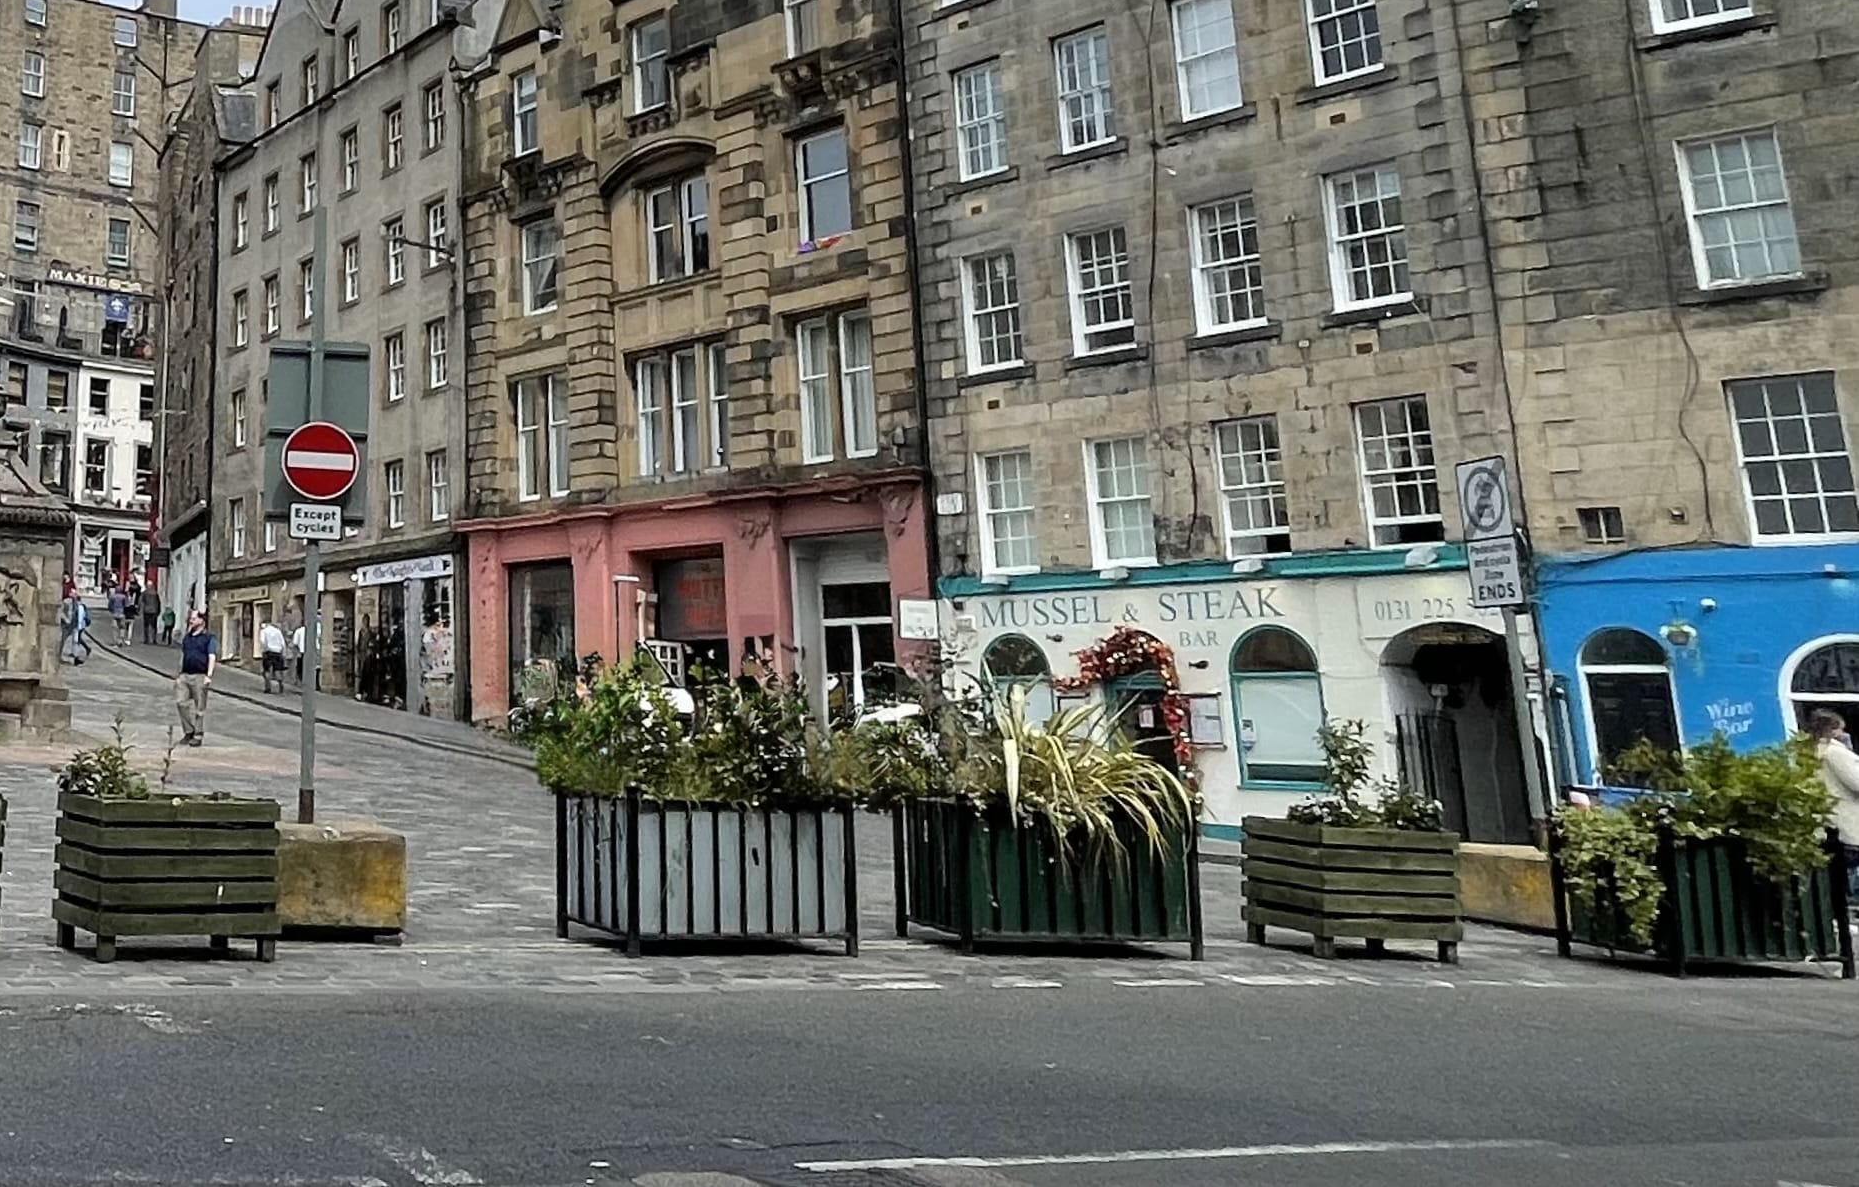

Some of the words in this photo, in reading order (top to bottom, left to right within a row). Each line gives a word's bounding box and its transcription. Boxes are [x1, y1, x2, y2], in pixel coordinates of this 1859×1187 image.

[295, 508, 337, 521] Except
[296, 523, 334, 533] cycles
[1478, 581, 1516, 600] ENDS
[981, 596, 1111, 627] MUSSEL
[1121, 602, 1139, 623] &
[1158, 586, 1285, 621] STEAK
[1374, 600, 1411, 620] 0131
[1422, 598, 1455, 619] 225
[1178, 630, 1220, 647] BAR
[1704, 698, 1754, 720] Wine
[1713, 718, 1753, 734] Bar
